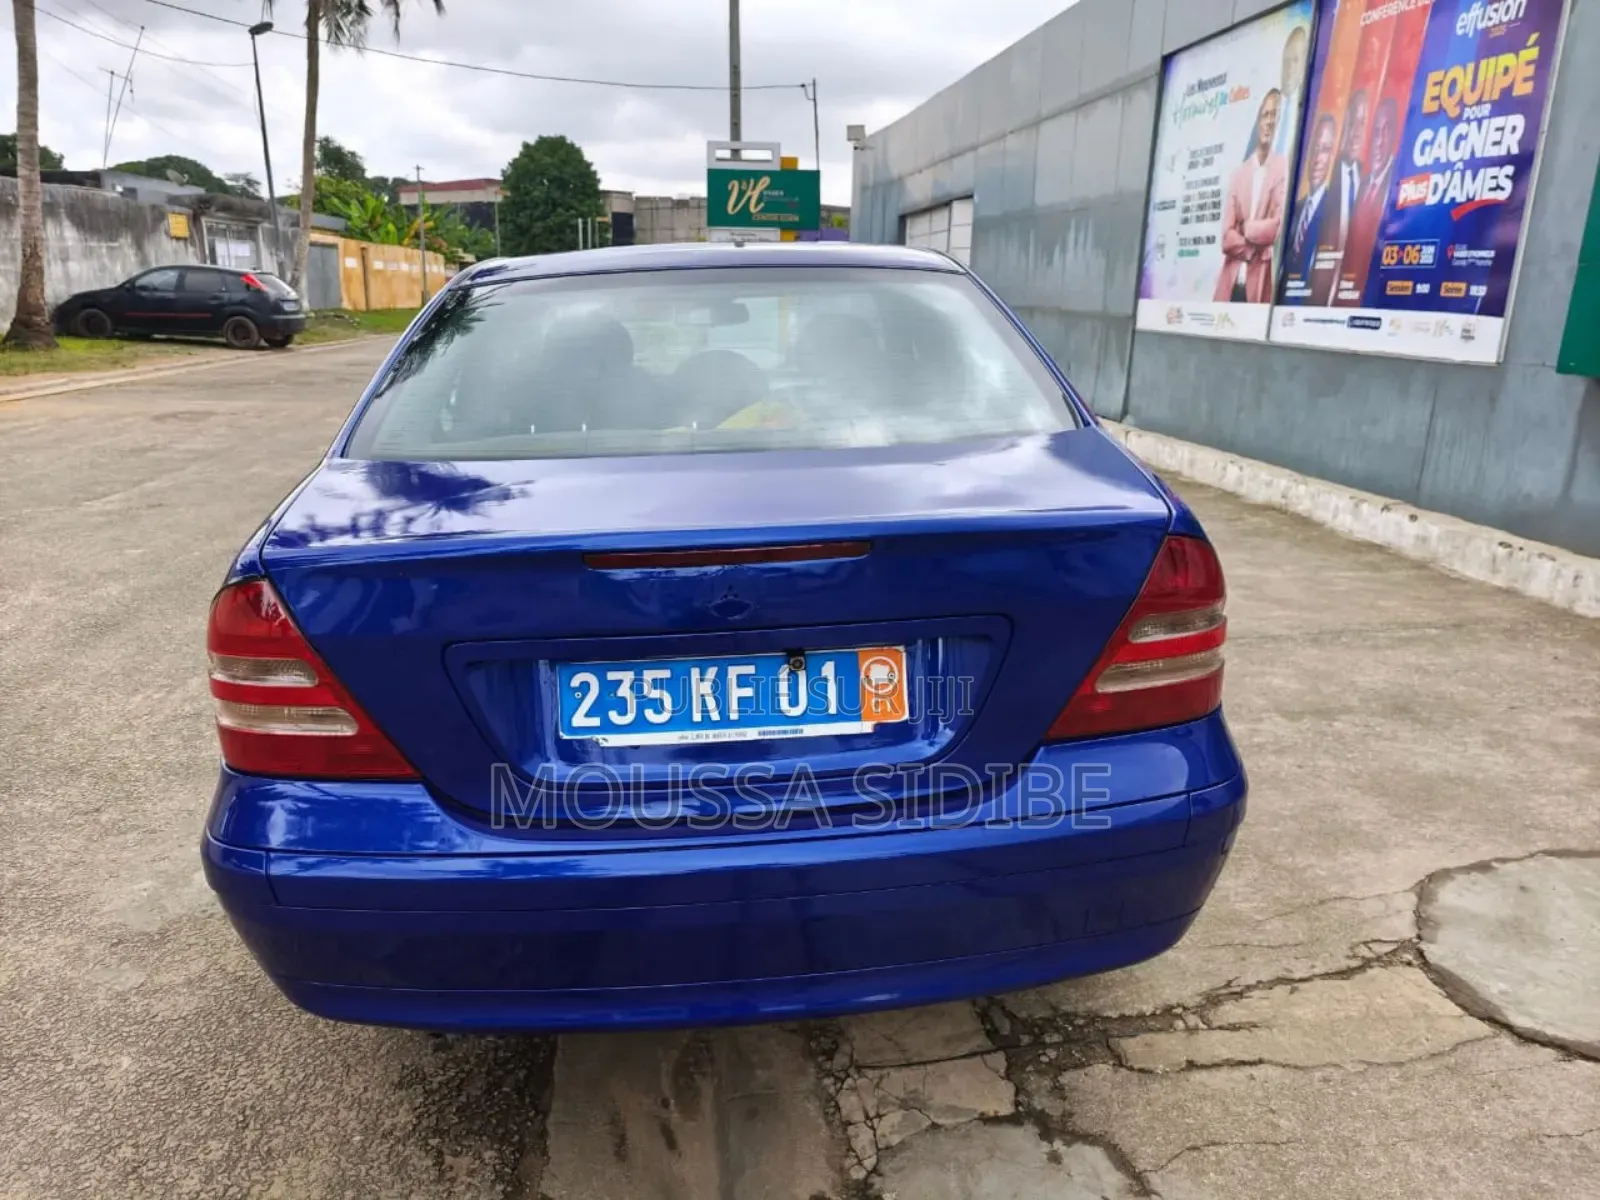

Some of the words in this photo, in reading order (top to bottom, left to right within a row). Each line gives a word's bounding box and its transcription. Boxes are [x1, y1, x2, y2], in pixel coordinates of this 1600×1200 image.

[1422, 32, 1540, 118] EQUIPÉ
[1463, 103, 1491, 120] POUR
[1412, 114, 1525, 166] GAGNER
[1425, 161, 1515, 205] D'ÂMES
[569, 669, 673, 727] 235
[690, 664, 756, 723] KF
[778, 660, 837, 717] 01
